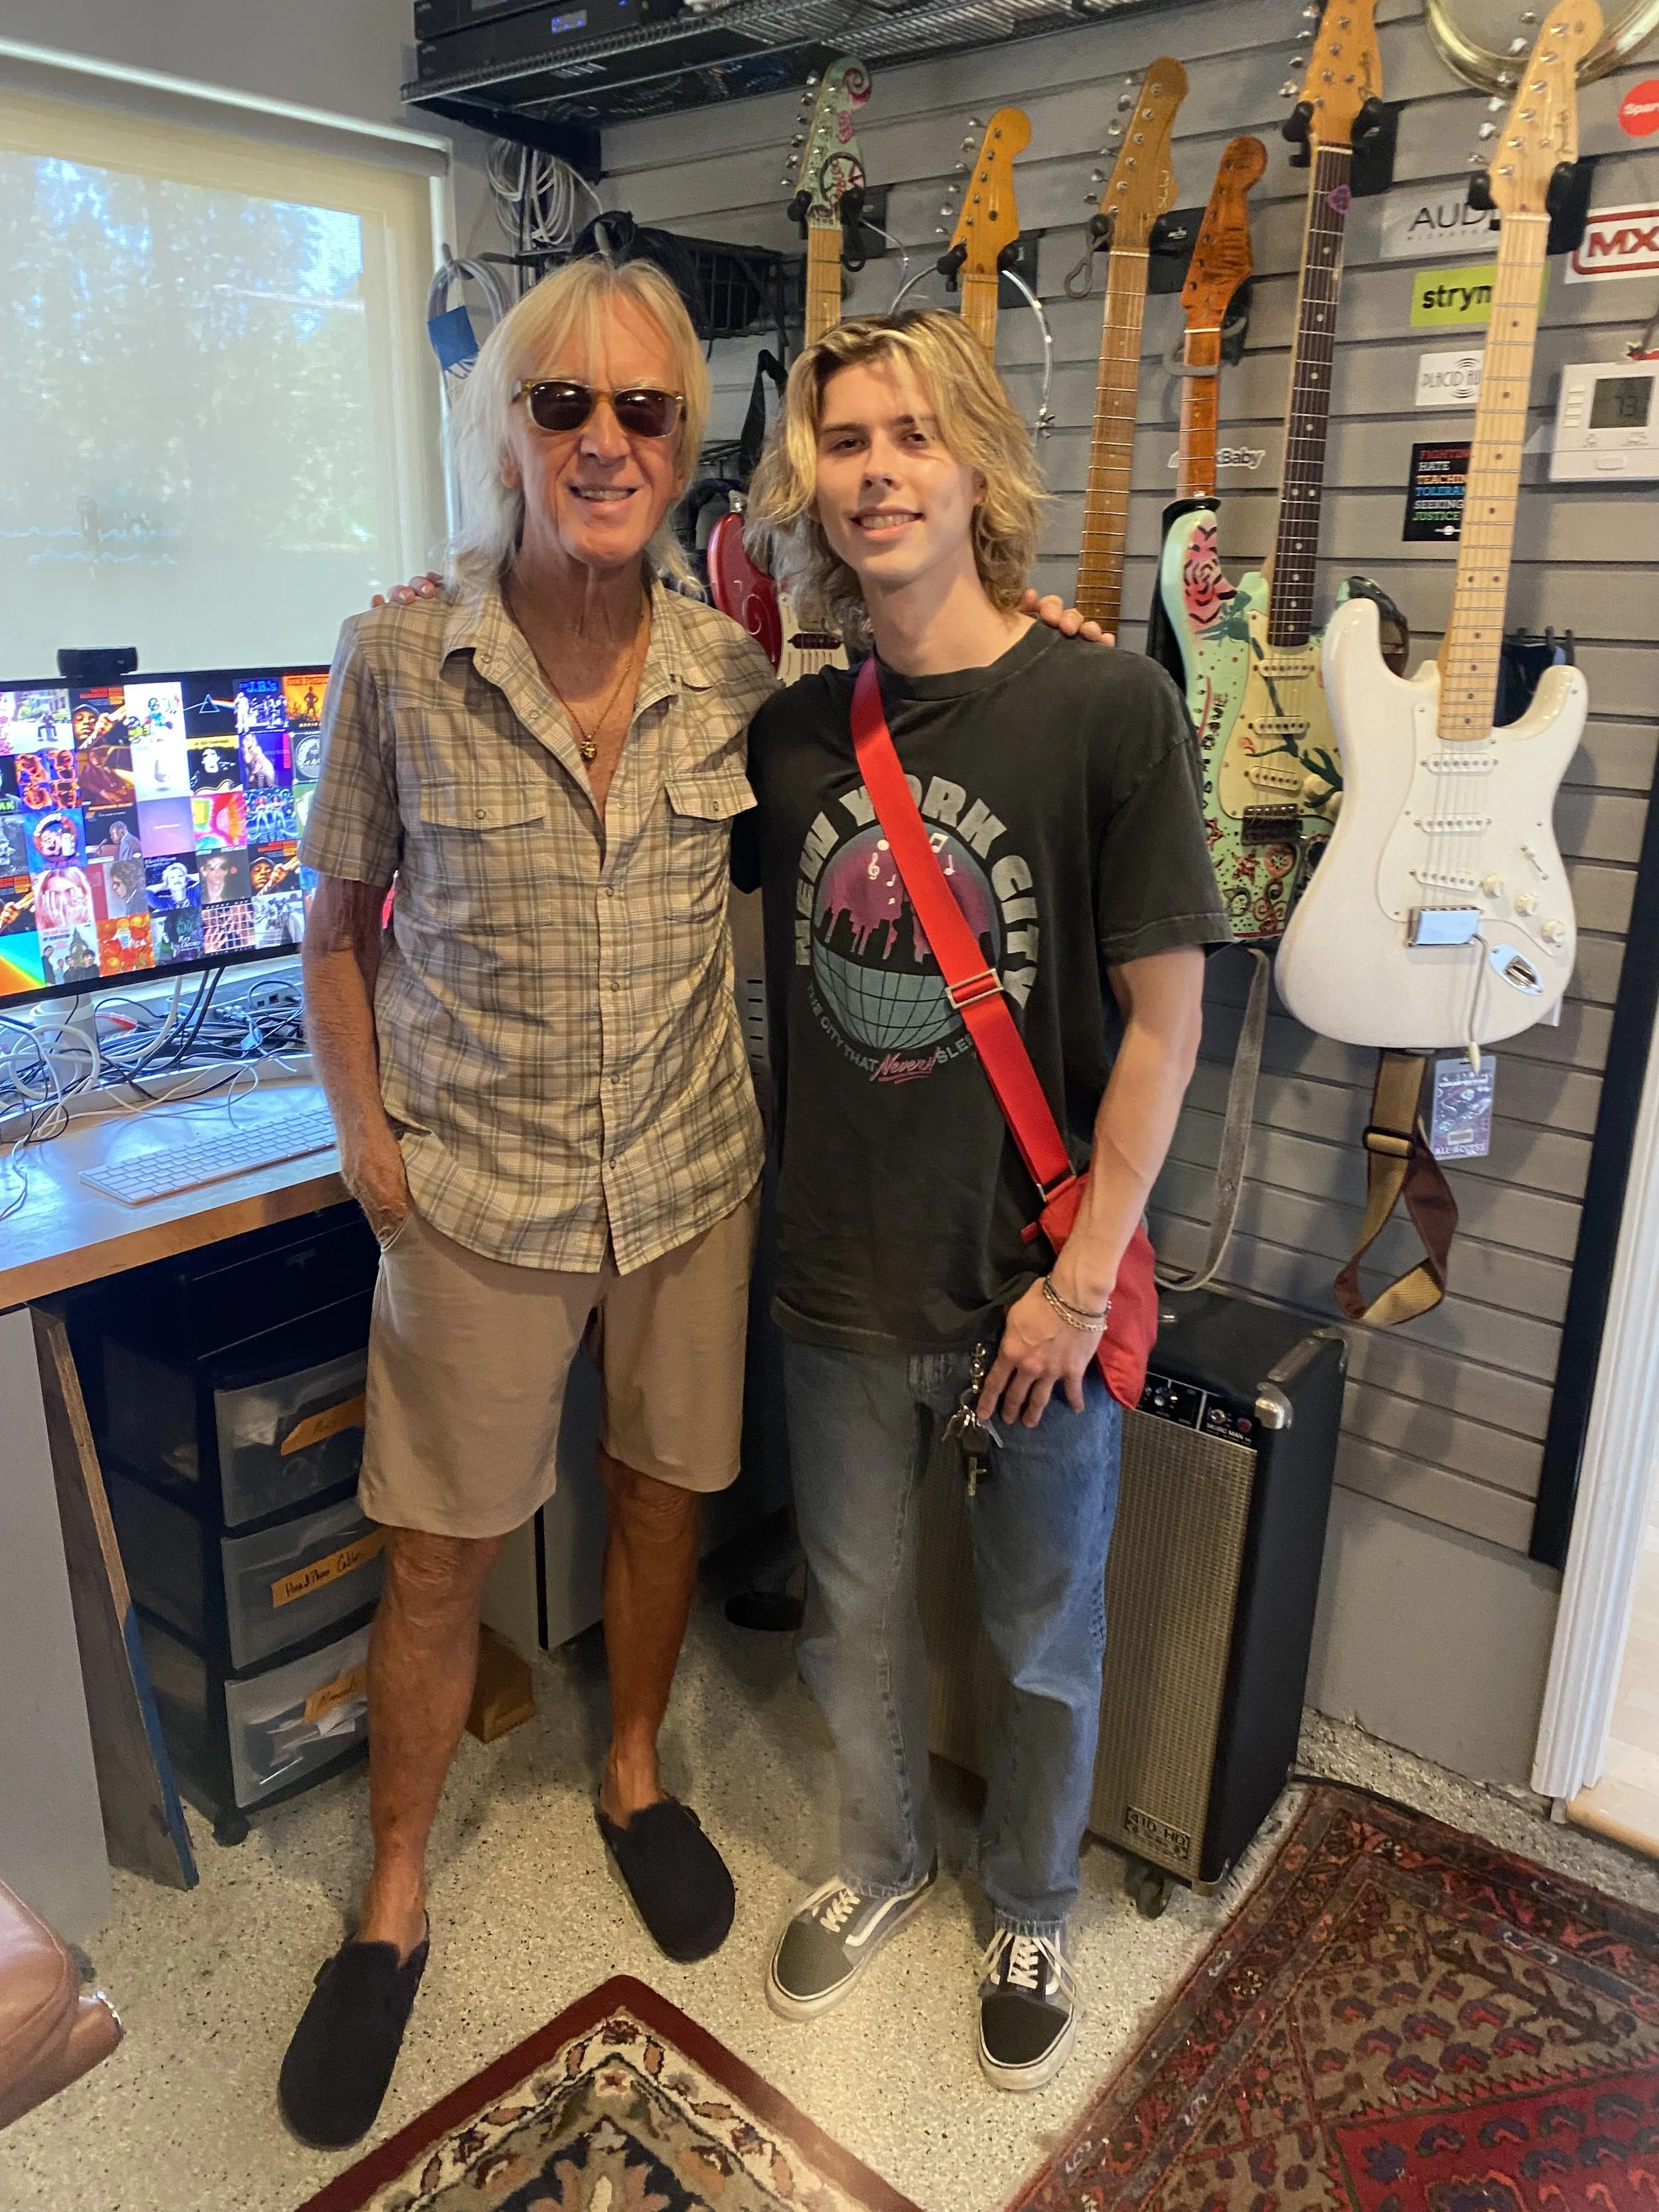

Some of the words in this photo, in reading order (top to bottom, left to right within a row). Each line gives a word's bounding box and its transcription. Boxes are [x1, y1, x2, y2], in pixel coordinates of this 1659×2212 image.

[1418, 461, 1450, 471] HATE
[794, 812, 839, 966] NEW
[991, 855, 1039, 1009] CITY
[821, 1016, 842, 1048] CITY
[844, 1046, 879, 1072] THAT
